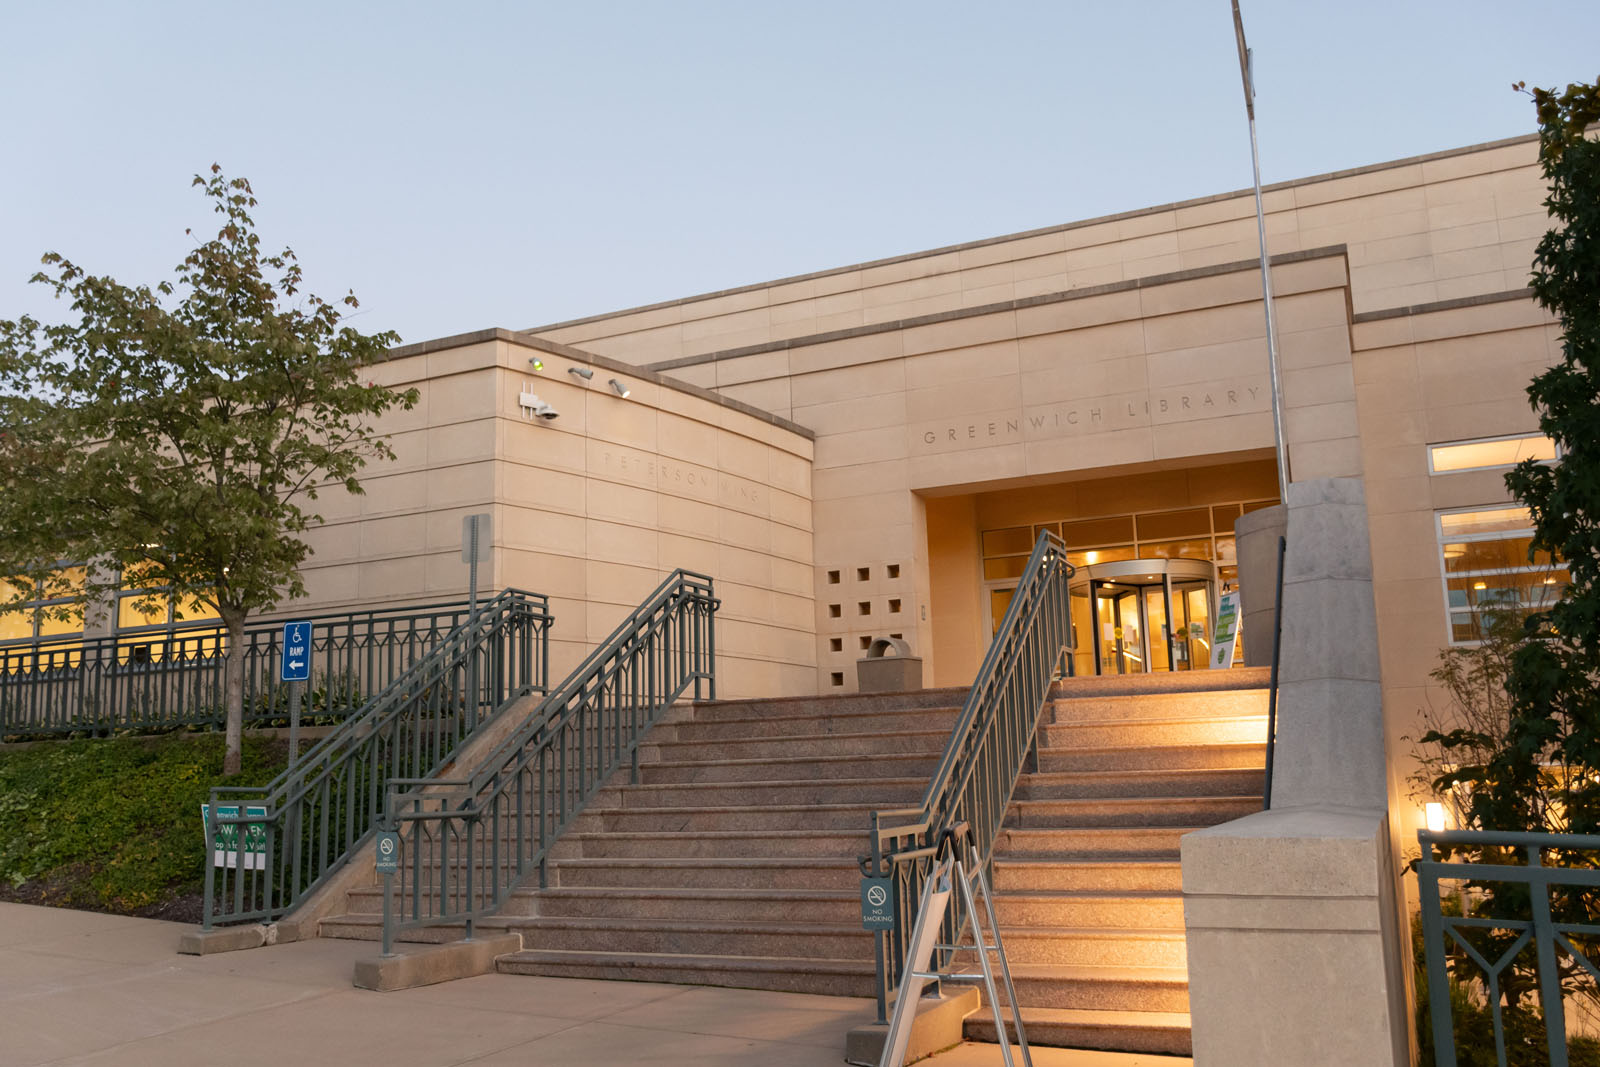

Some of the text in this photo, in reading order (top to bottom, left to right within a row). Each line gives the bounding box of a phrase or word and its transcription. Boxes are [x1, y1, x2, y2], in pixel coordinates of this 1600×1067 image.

[924, 387, 1259, 444] GREENWICH LIBRARY
[603, 452, 708, 487] PETERSON
[289, 646, 305, 657] RAMP
